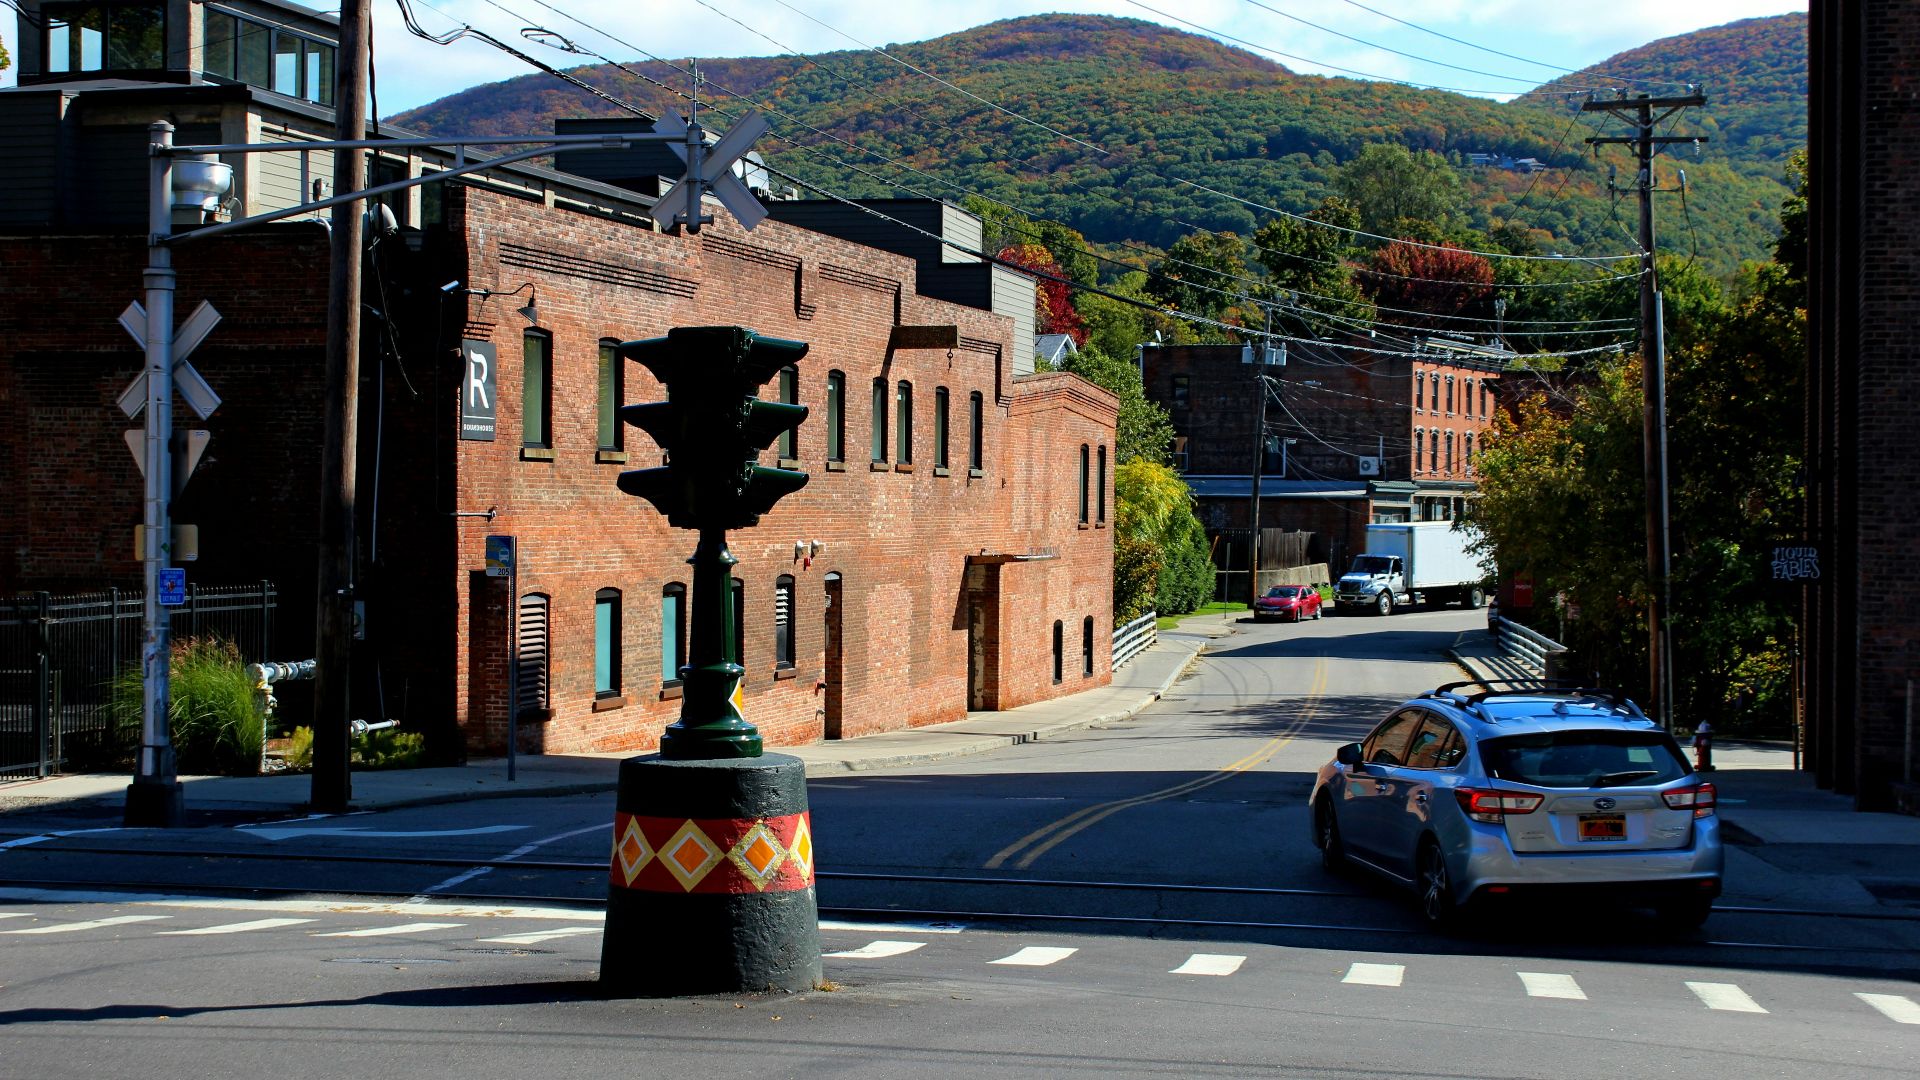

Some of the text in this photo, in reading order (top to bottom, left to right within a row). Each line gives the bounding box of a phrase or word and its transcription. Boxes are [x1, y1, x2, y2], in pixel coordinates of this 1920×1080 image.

[470, 349, 490, 409] R
[1771, 547, 1818, 565] LIQUID
[497, 568, 510, 576] 205
[1772, 558, 1821, 581] FABLES
